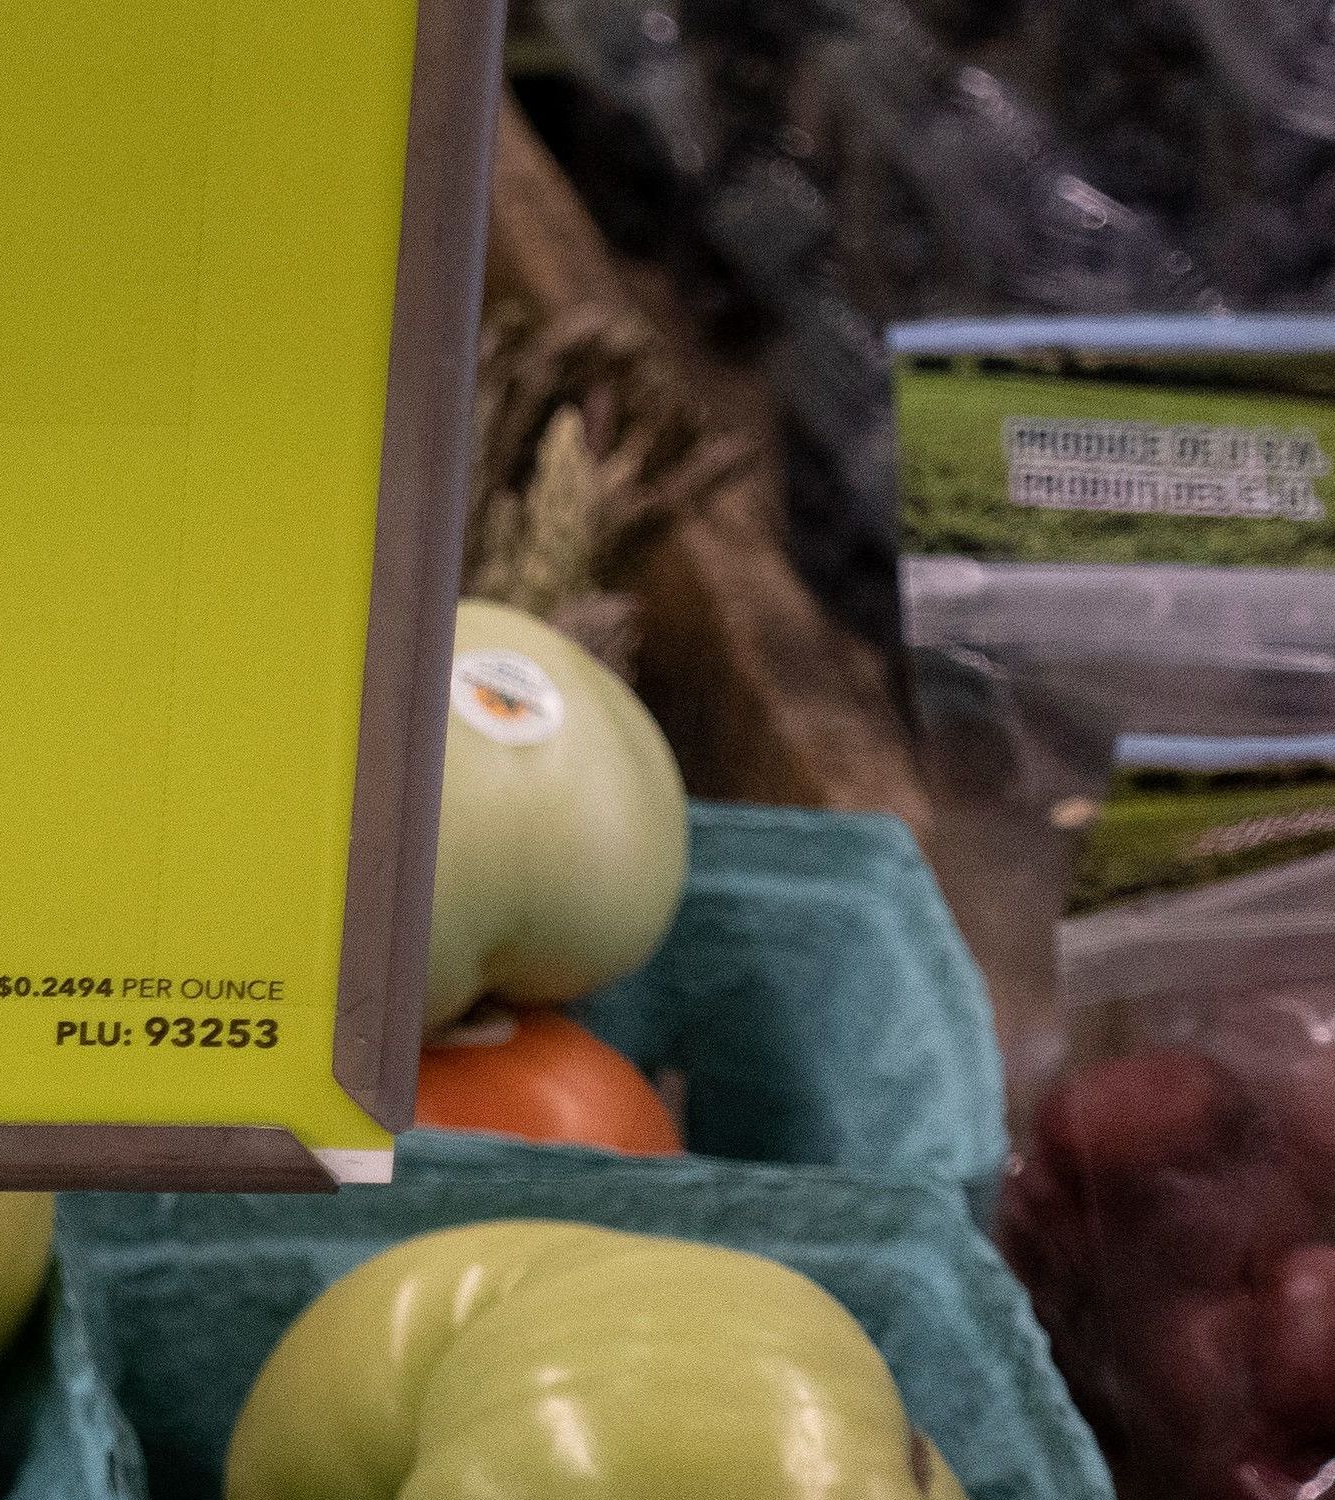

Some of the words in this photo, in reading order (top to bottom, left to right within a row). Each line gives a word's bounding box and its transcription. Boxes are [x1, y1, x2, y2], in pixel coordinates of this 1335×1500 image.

[122, 979, 173, 999] PER
[180, 980, 285, 1001] OUNCE
[56, 1021, 133, 1047] PLU:
[145, 1016, 279, 1050] 93253
